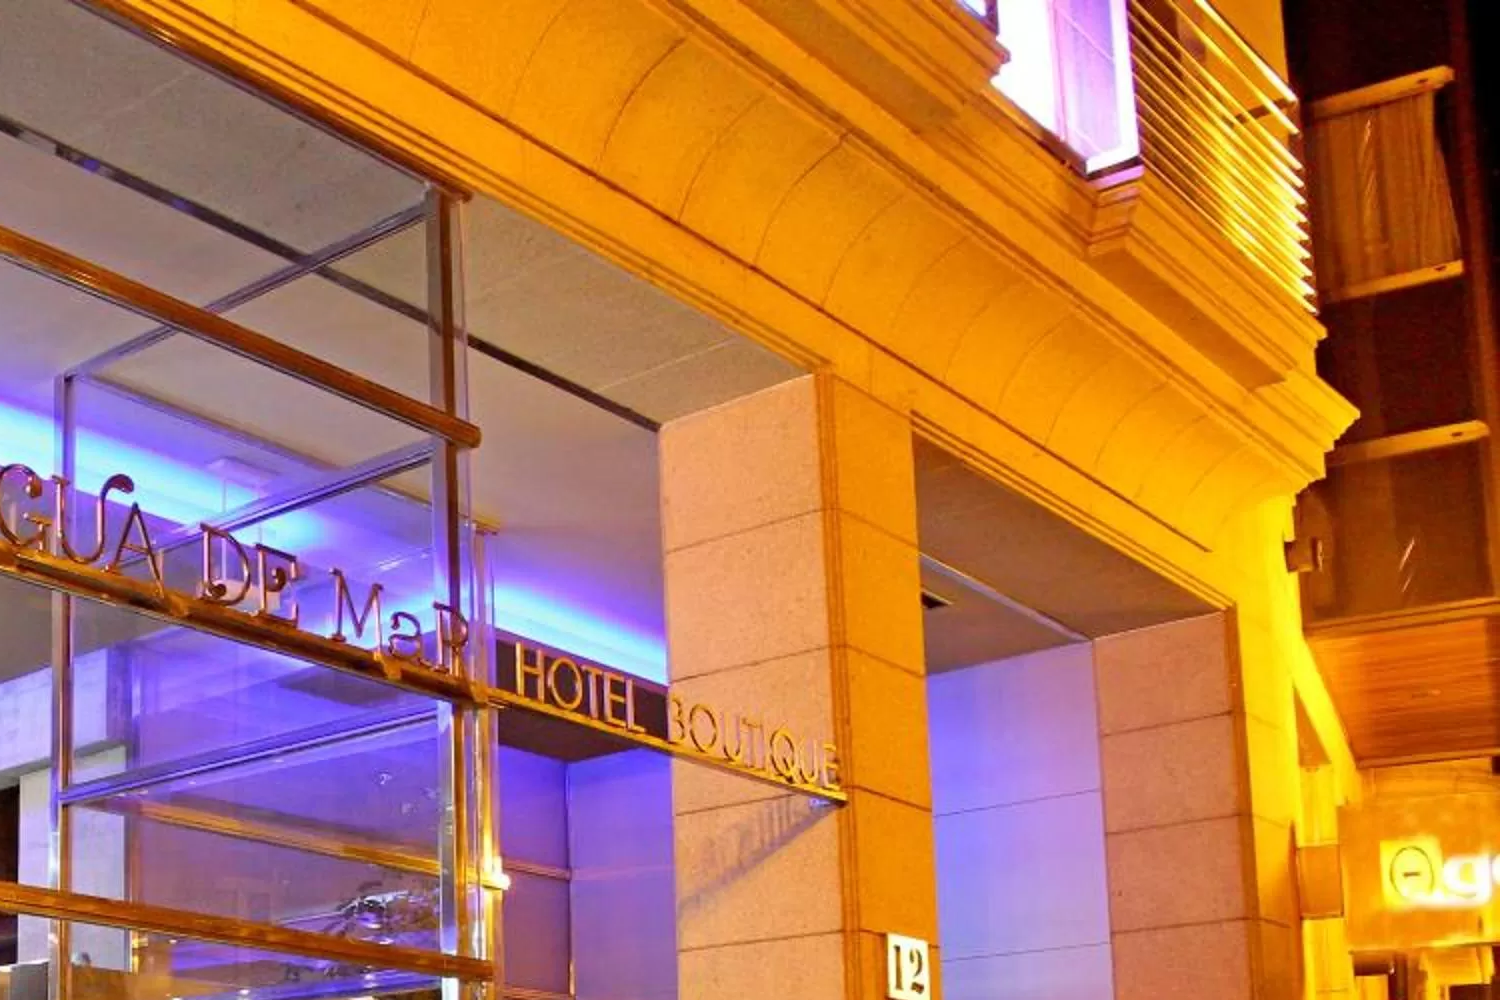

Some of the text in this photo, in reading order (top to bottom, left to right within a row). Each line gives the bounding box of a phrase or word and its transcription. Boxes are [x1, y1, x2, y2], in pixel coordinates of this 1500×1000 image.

[199, 522, 299, 628] DE
[515, 641, 841, 790] HOTEL BOUTIQUE
[893, 944, 925, 994] 12
